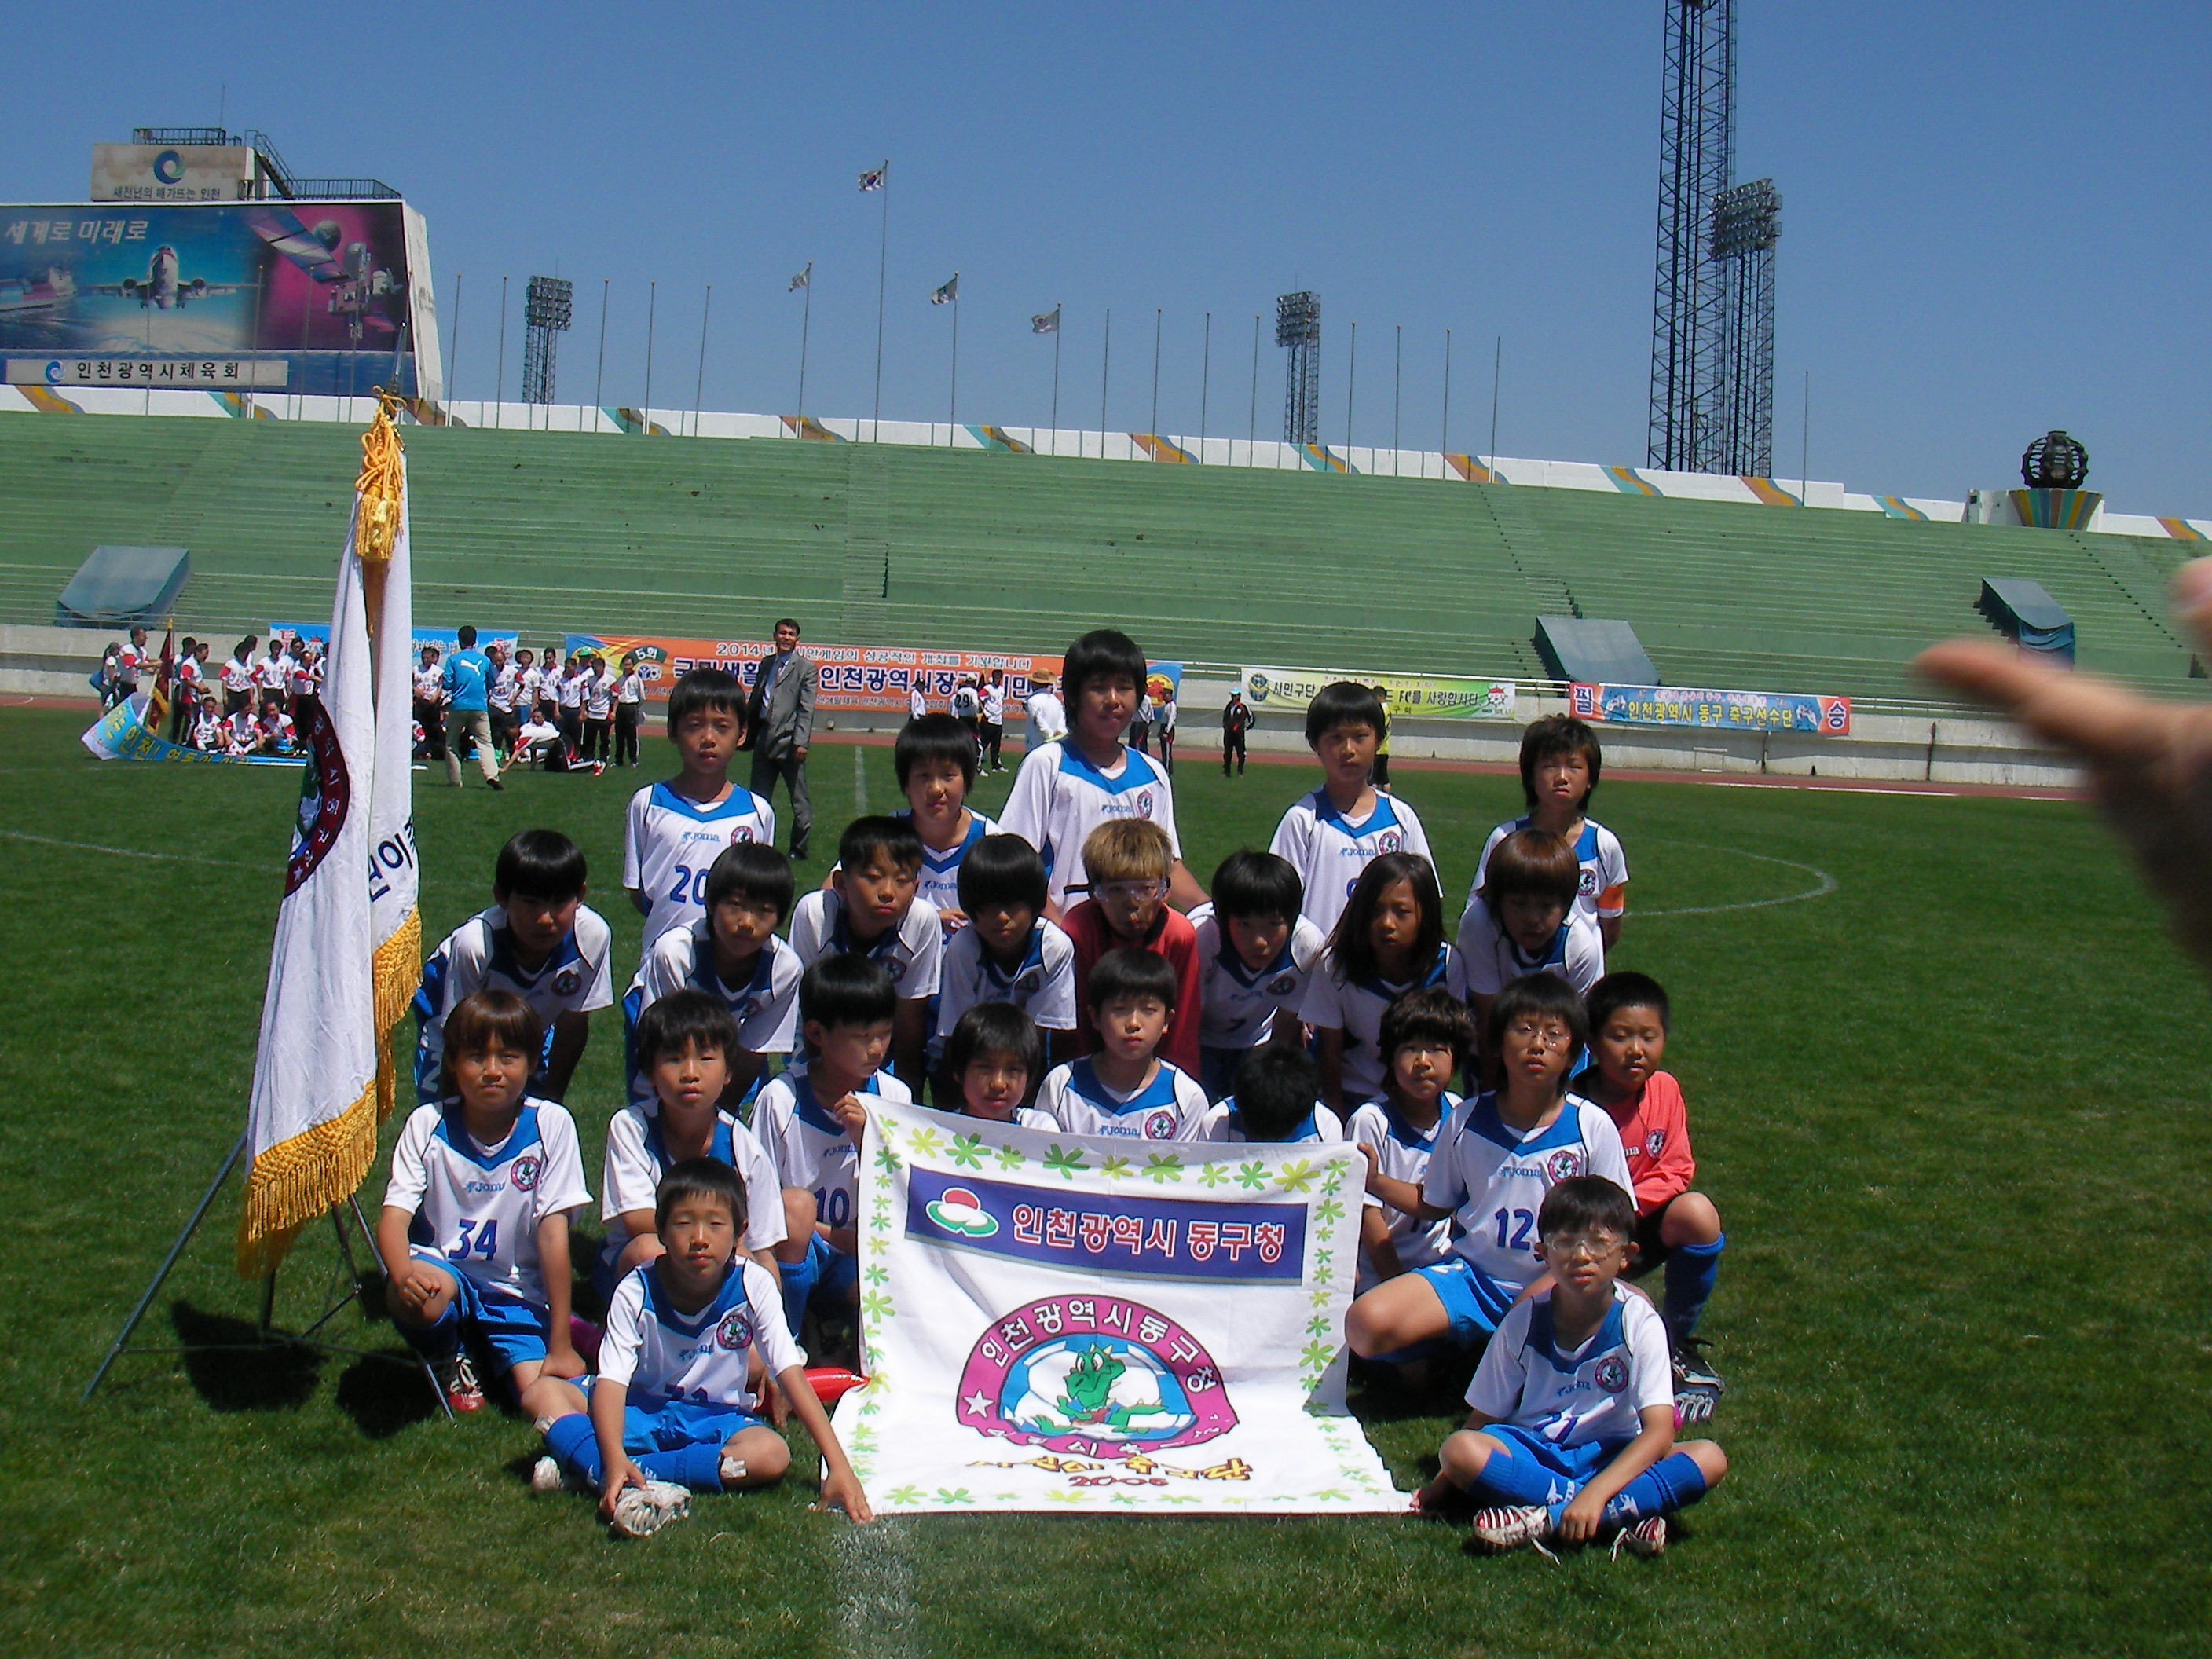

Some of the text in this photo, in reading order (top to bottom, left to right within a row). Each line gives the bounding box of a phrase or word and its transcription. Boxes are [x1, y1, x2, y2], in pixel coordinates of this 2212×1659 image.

[200, 187, 221, 200] 인천
[5, 220, 149, 244] 세계로 미래로
[77, 361, 239, 380] 인천광역시체육회
[864, 650, 916, 665] 성공적인
[921, 652, 961, 666] 개최를
[965, 654, 1031, 671] 기원합니다
[1273, 681, 1316, 698] 시민구단
[1574, 685, 1594, 716] 필
[1628, 701, 1793, 730] 인천광역시 동구 축구선수단
[1827, 700, 1847, 730] 승
[814, 1186, 850, 1228] 10
[447, 1218, 499, 1261] 34
[1011, 1202, 1286, 1264] 인천광역시 동구청
[1495, 1207, 1534, 1251] 12
